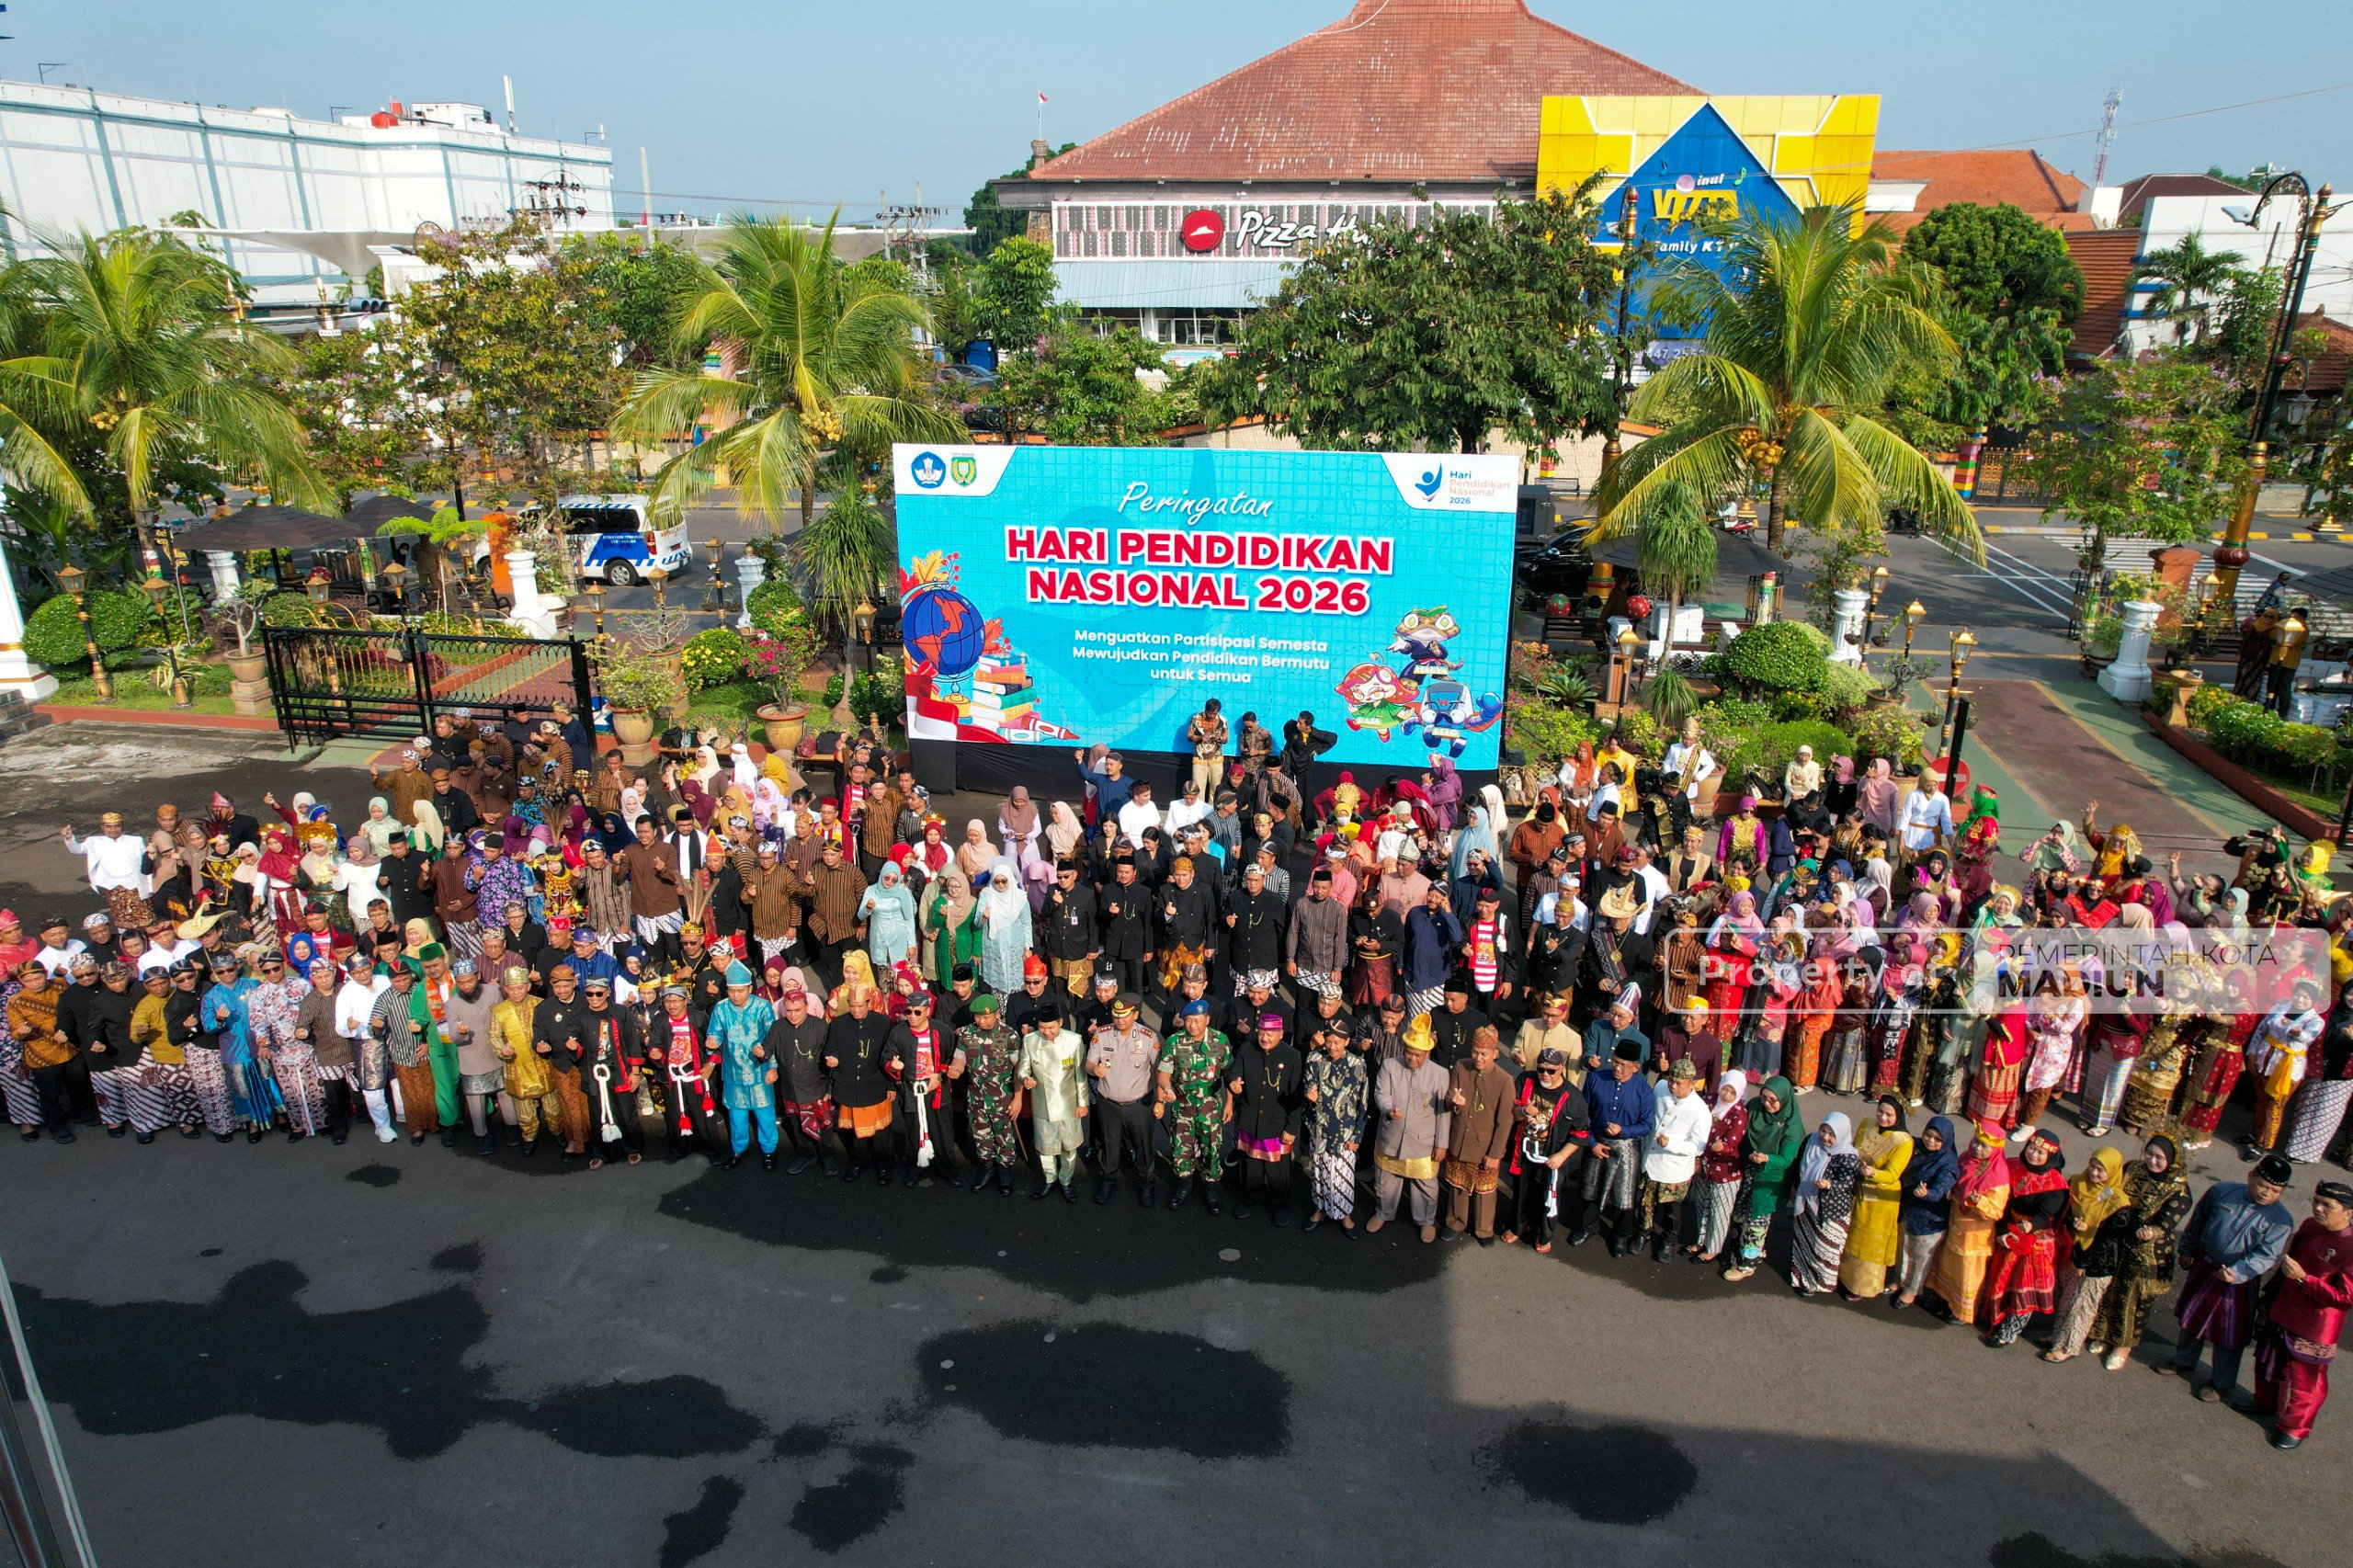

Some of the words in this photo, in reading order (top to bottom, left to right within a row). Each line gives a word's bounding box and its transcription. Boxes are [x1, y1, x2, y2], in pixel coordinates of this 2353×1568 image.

[1235, 209, 1318, 249] Pizza
[1326, 212, 1385, 244] Hu
[1449, 471, 1472, 479] Hari
[1449, 479, 1510, 489] Pendidikan
[1449, 487, 1495, 496] Nasional
[1118, 481, 1274, 526] Peringatan
[1006, 528, 1107, 562] HARI
[1119, 531, 1392, 574] PENDIDIKAN
[1029, 569, 1247, 608] NASIONAL
[1257, 579, 1370, 613] 2026
[1074, 630, 1171, 646] Menguatkan
[1174, 633, 1256, 652] Partisipasi
[1258, 637, 1327, 653] Semesta
[1073, 646, 1169, 663] Mewujudkan
[1172, 650, 1258, 666] Pendidikan
[1261, 656, 1330, 670] Bermutu
[1150, 668, 1194, 681] untuk
[1197, 669, 1251, 684] Semua
